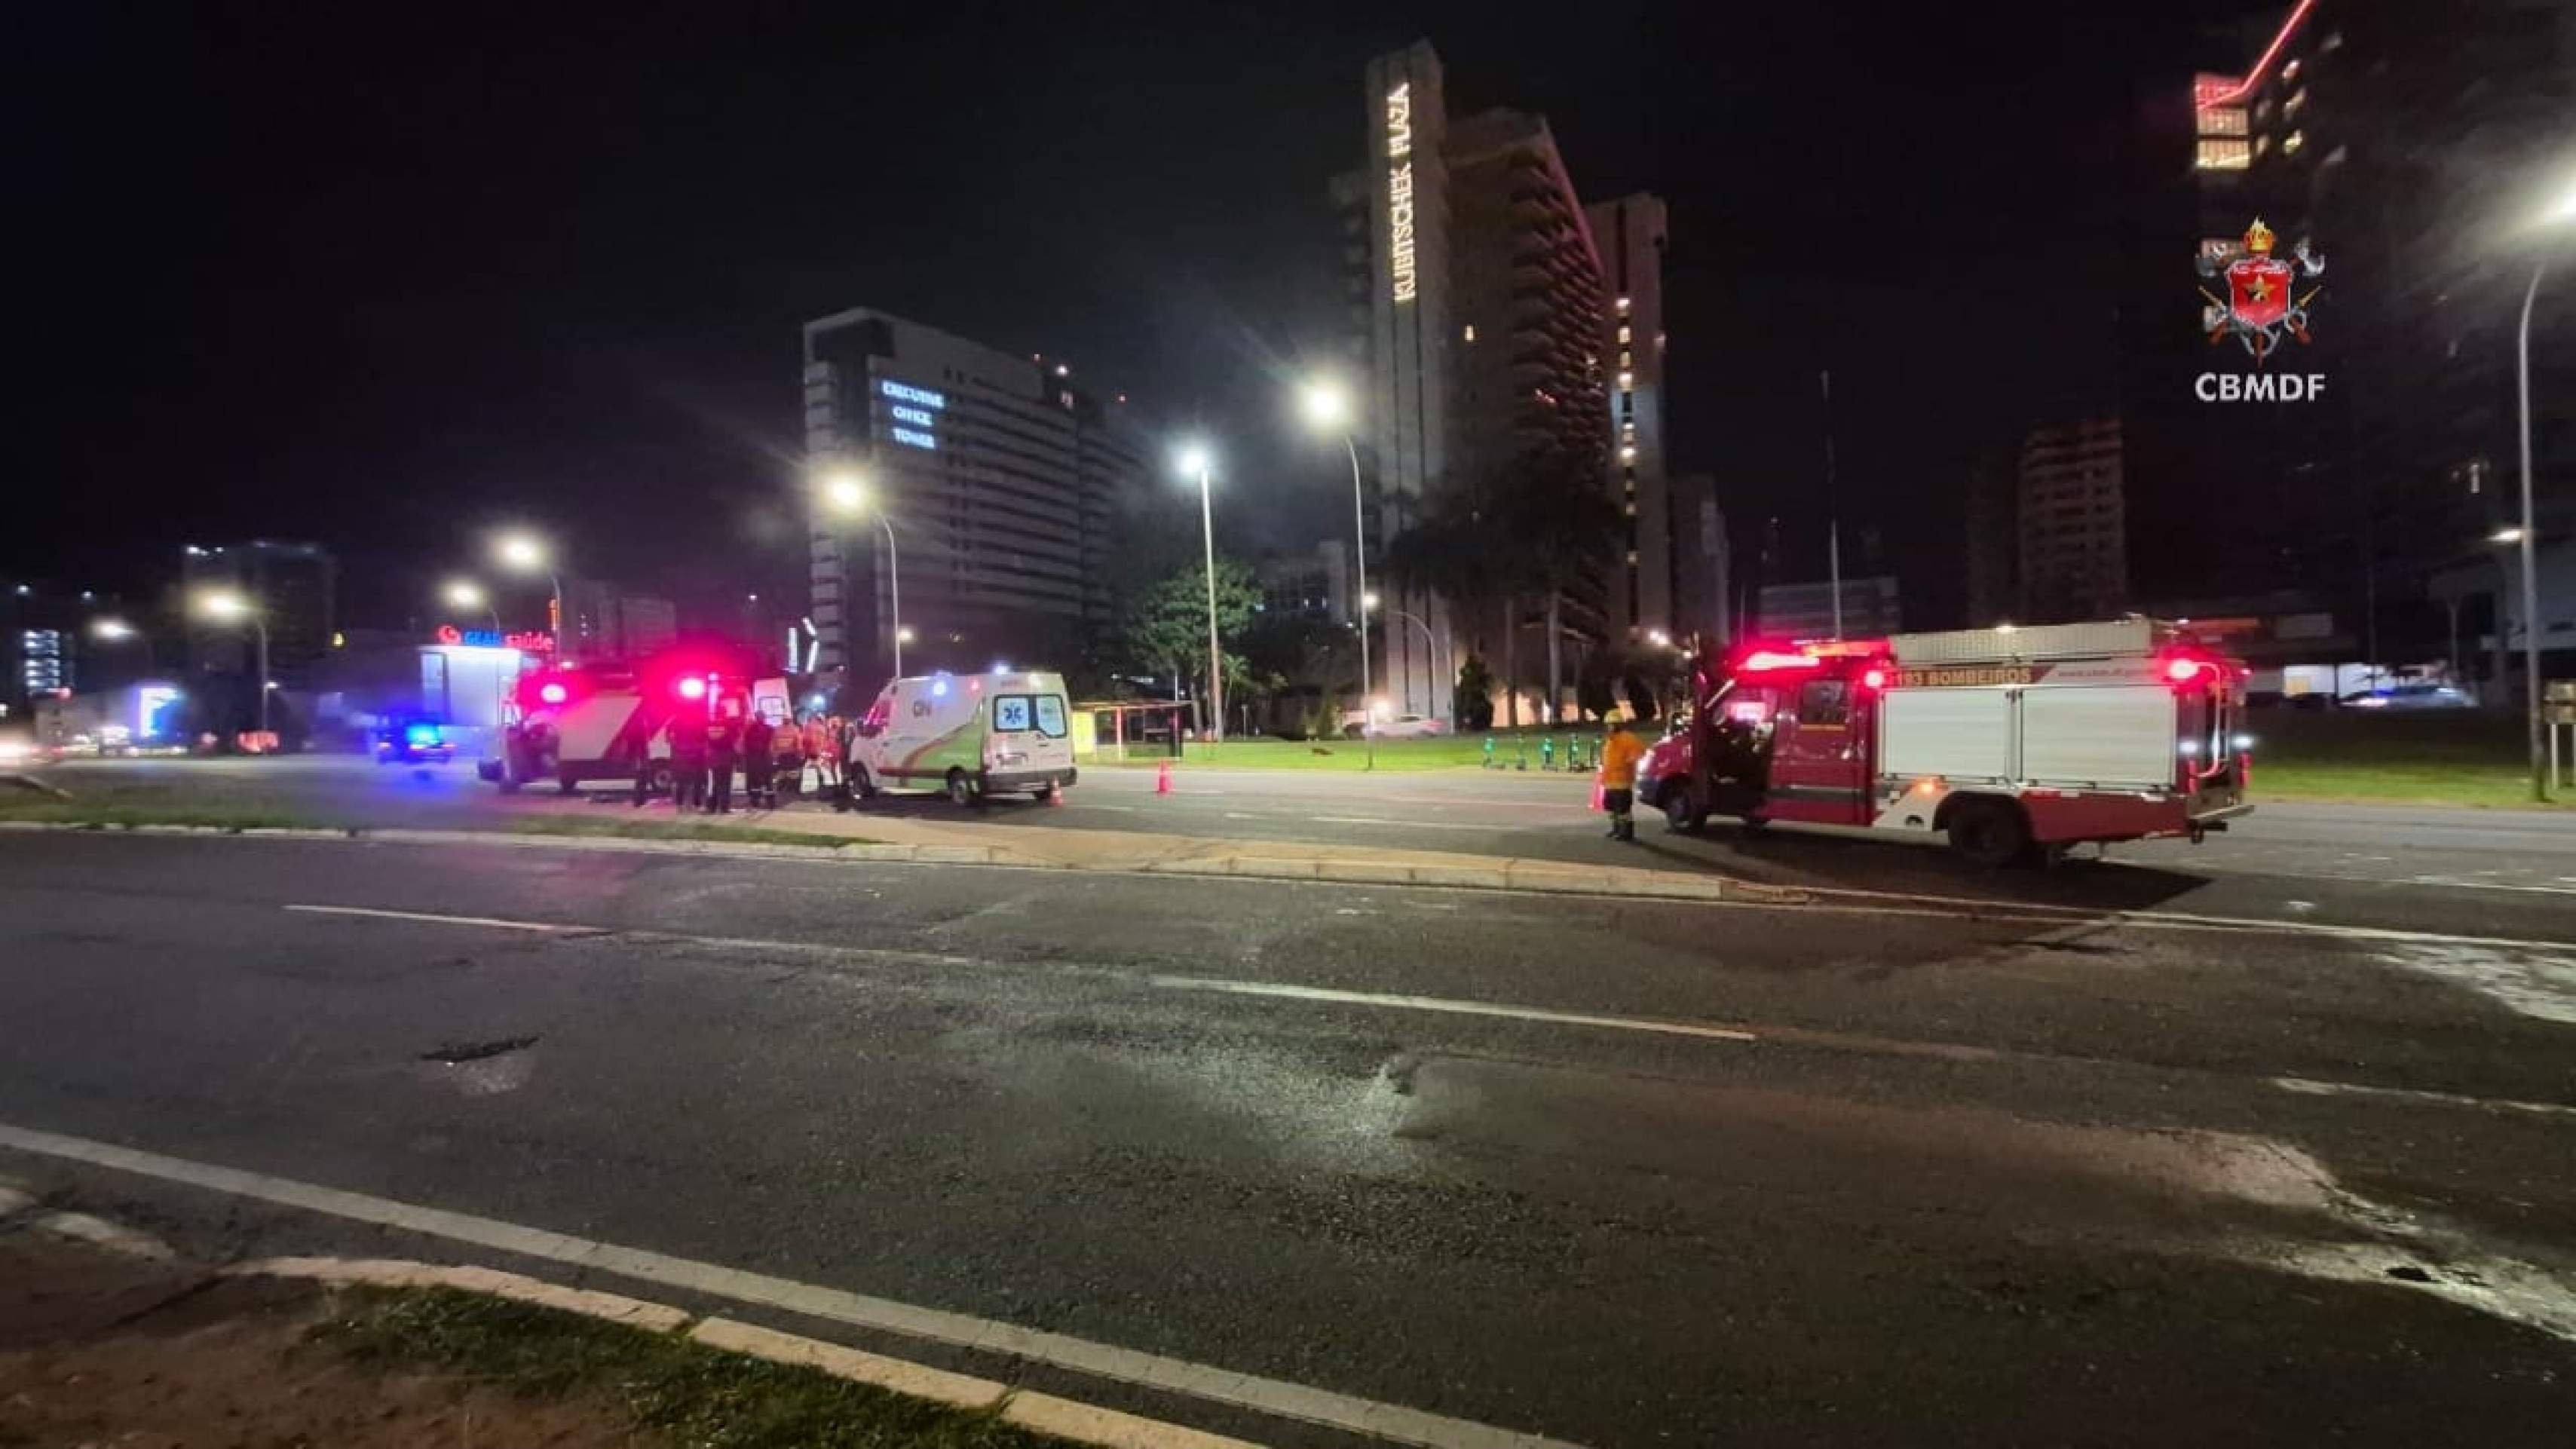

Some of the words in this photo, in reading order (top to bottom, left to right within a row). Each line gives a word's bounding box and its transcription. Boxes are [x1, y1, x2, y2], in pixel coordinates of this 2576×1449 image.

[1386, 82, 1411, 157] PLAZA
[1389, 163, 1416, 302] KUBITSCHEK
[881, 380, 944, 409] EXECUTIVE
[893, 406, 933, 427] OFFICE
[893, 427, 935, 449] TOWER
[1928, 666, 2032, 686] BOMBEIROS
